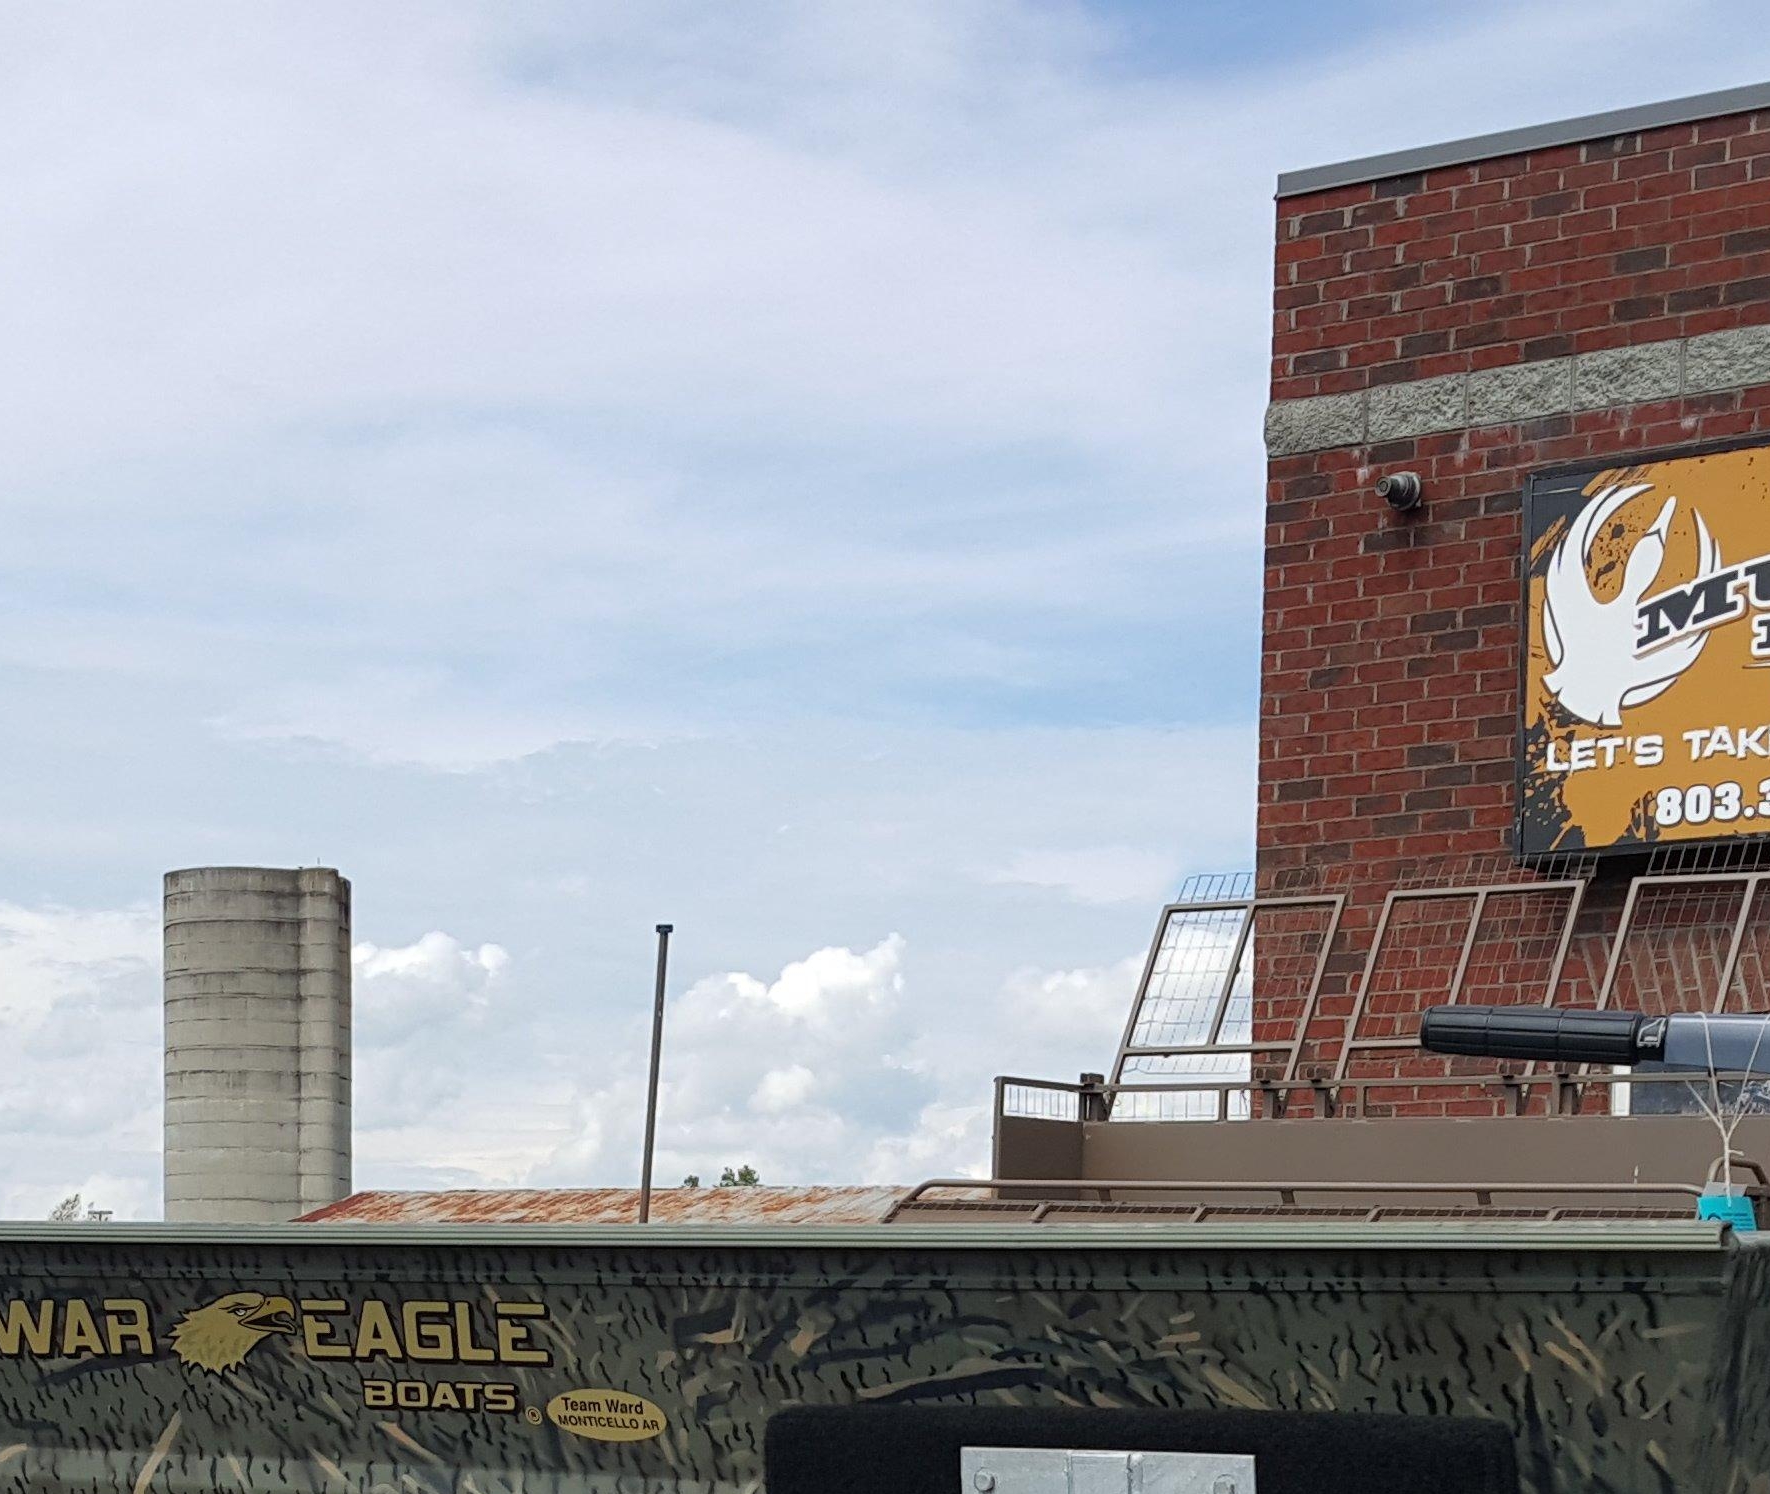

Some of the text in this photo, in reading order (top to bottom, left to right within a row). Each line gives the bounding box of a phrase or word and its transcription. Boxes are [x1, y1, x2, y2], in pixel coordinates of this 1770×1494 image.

[1546, 732, 1664, 773] LET'S
[299, 1299, 552, 1365] EAGLE
[363, 1379, 517, 1411] BOATS
[561, 1397, 644, 1415] Team Ward
[558, 1414, 660, 1430] MONTICELLO AR
